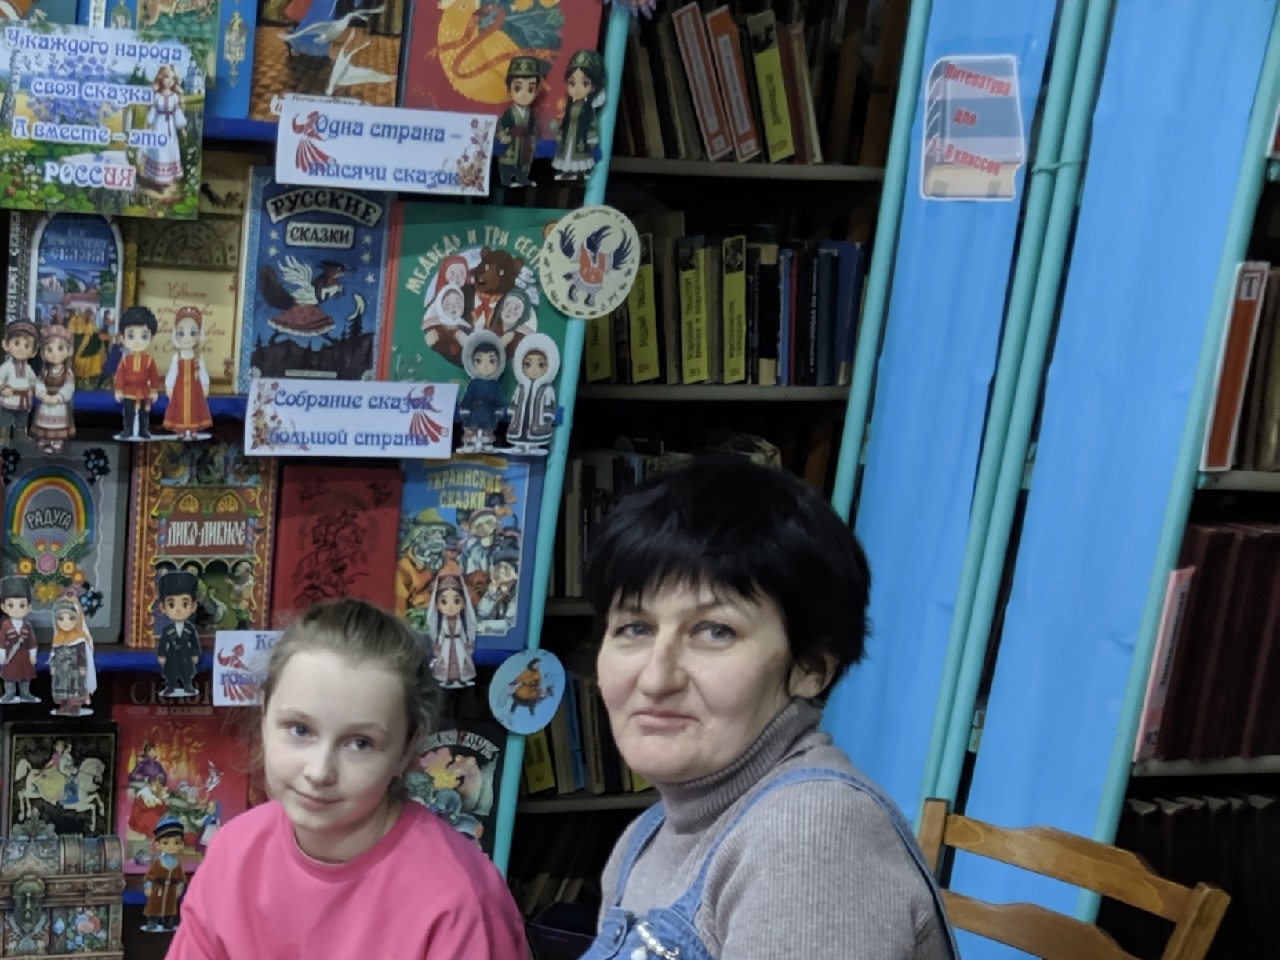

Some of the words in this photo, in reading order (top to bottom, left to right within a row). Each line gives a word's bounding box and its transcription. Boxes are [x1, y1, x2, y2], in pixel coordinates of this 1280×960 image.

[25, 36, 110, 56] каждого
[114, 43, 182, 62] народа
[32, 80, 78, 97] своя
[83, 84, 152, 106] сказка
[944, 63, 1012, 97] Литература
[315, 113, 364, 139] Одна
[370, 122, 445, 144] страна
[953, 108, 977, 127] для
[12, 119, 28, 138] А
[34, 125, 109, 144] вместе
[129, 130, 168, 148] это
[44, 160, 136, 189] РОССИЯ
[307, 161, 387, 182] тысячи
[393, 167, 461, 189] сказок
[954, 148, 1002, 176] классов
[271, 190, 377, 222] РУССКИЕ
[290, 227, 350, 243] СКАЗКИ
[405, 233, 461, 295] МЕДВЕДЬ
[467, 230, 477, 245] И
[484, 225, 509, 246] ТРИ
[274, 390, 362, 412] Собрание
[368, 393, 432, 414] сказок
[268, 428, 348, 447] большой
[354, 431, 430, 450] страны
[440, 490, 486, 511] СКАЗКИ
[26, 507, 72, 530] РАДУГА
